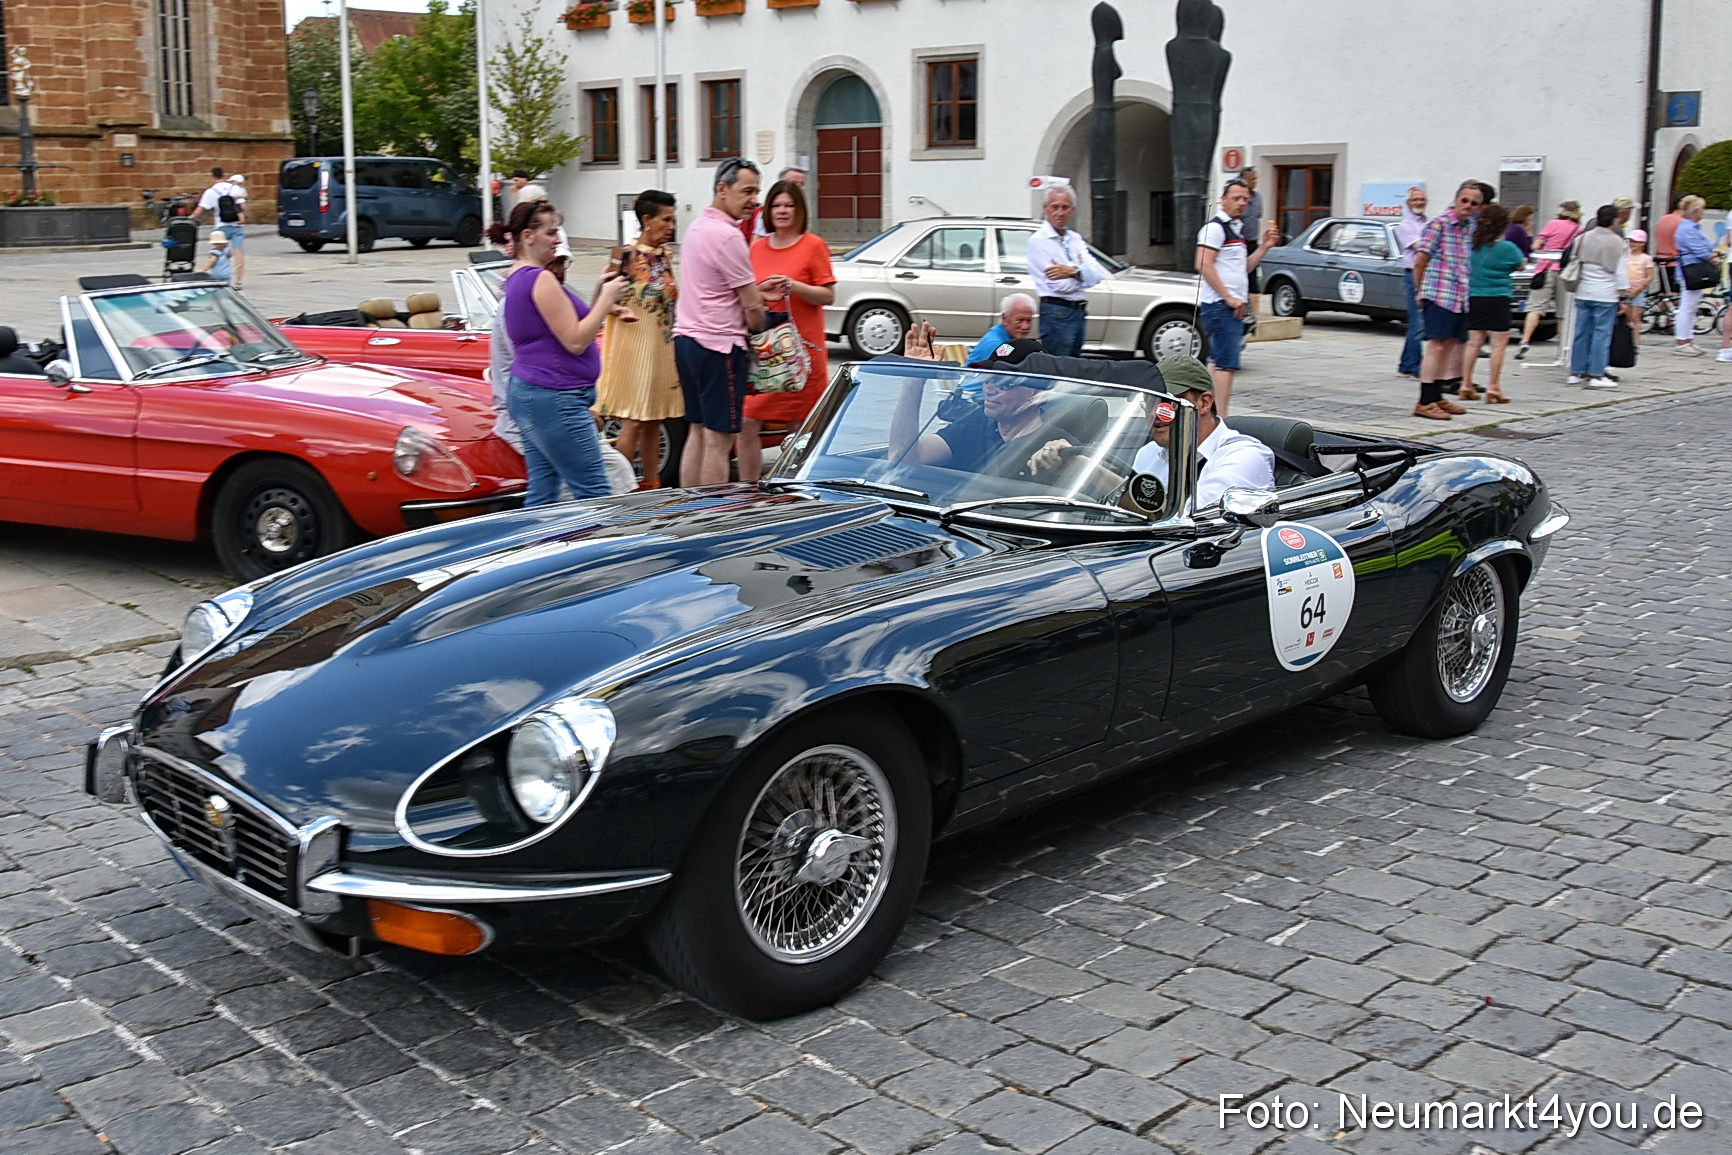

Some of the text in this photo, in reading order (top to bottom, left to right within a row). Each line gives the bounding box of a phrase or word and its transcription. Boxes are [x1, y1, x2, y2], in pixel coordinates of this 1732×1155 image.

[1363, 203, 1404, 215] Kunst
[1136, 496, 1159, 506] JAGUAR
[1300, 592, 1326, 629] 64
